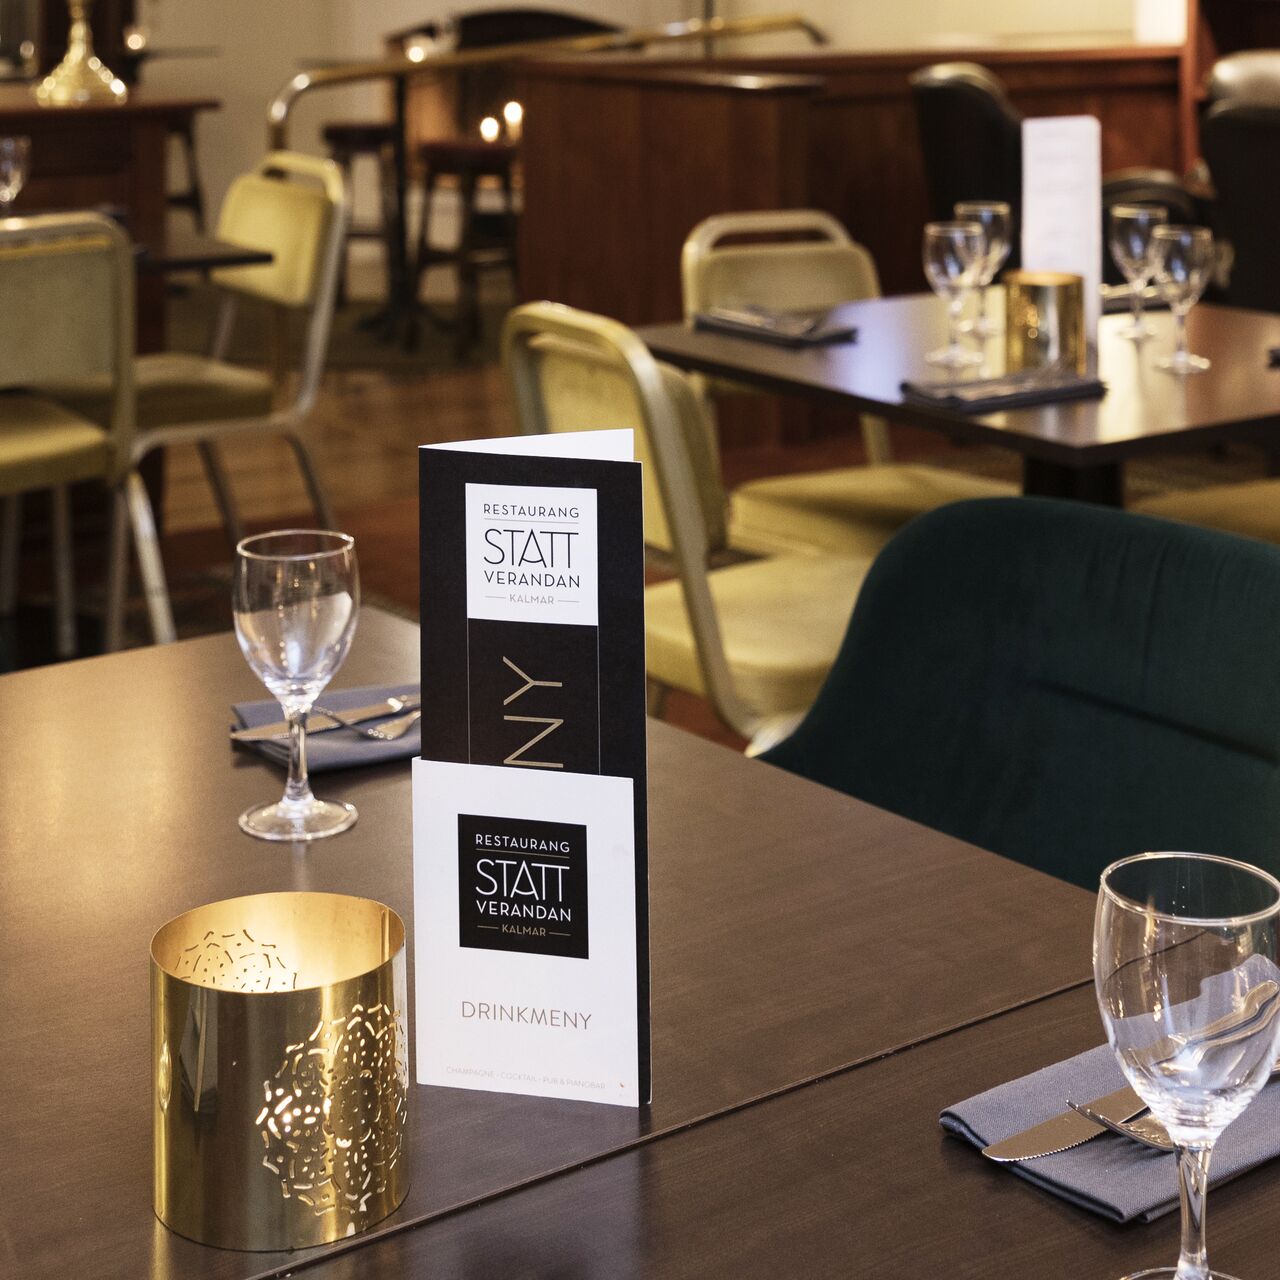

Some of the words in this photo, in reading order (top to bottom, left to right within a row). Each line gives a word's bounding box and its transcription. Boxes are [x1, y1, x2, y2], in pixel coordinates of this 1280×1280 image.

[483, 503, 580, 518] RESTAURANG
[483, 528, 579, 569] STATT
[483, 570, 580, 588] VERANDAN
[509, 593, 554, 605] KALMAR
[475, 833, 570, 853] RESTAURANG
[475, 858, 570, 902] STATT
[475, 900, 571, 922] VERANDAN
[502, 924, 546, 937] KALMAR
[461, 1001, 592, 1030] DRINKMENY
